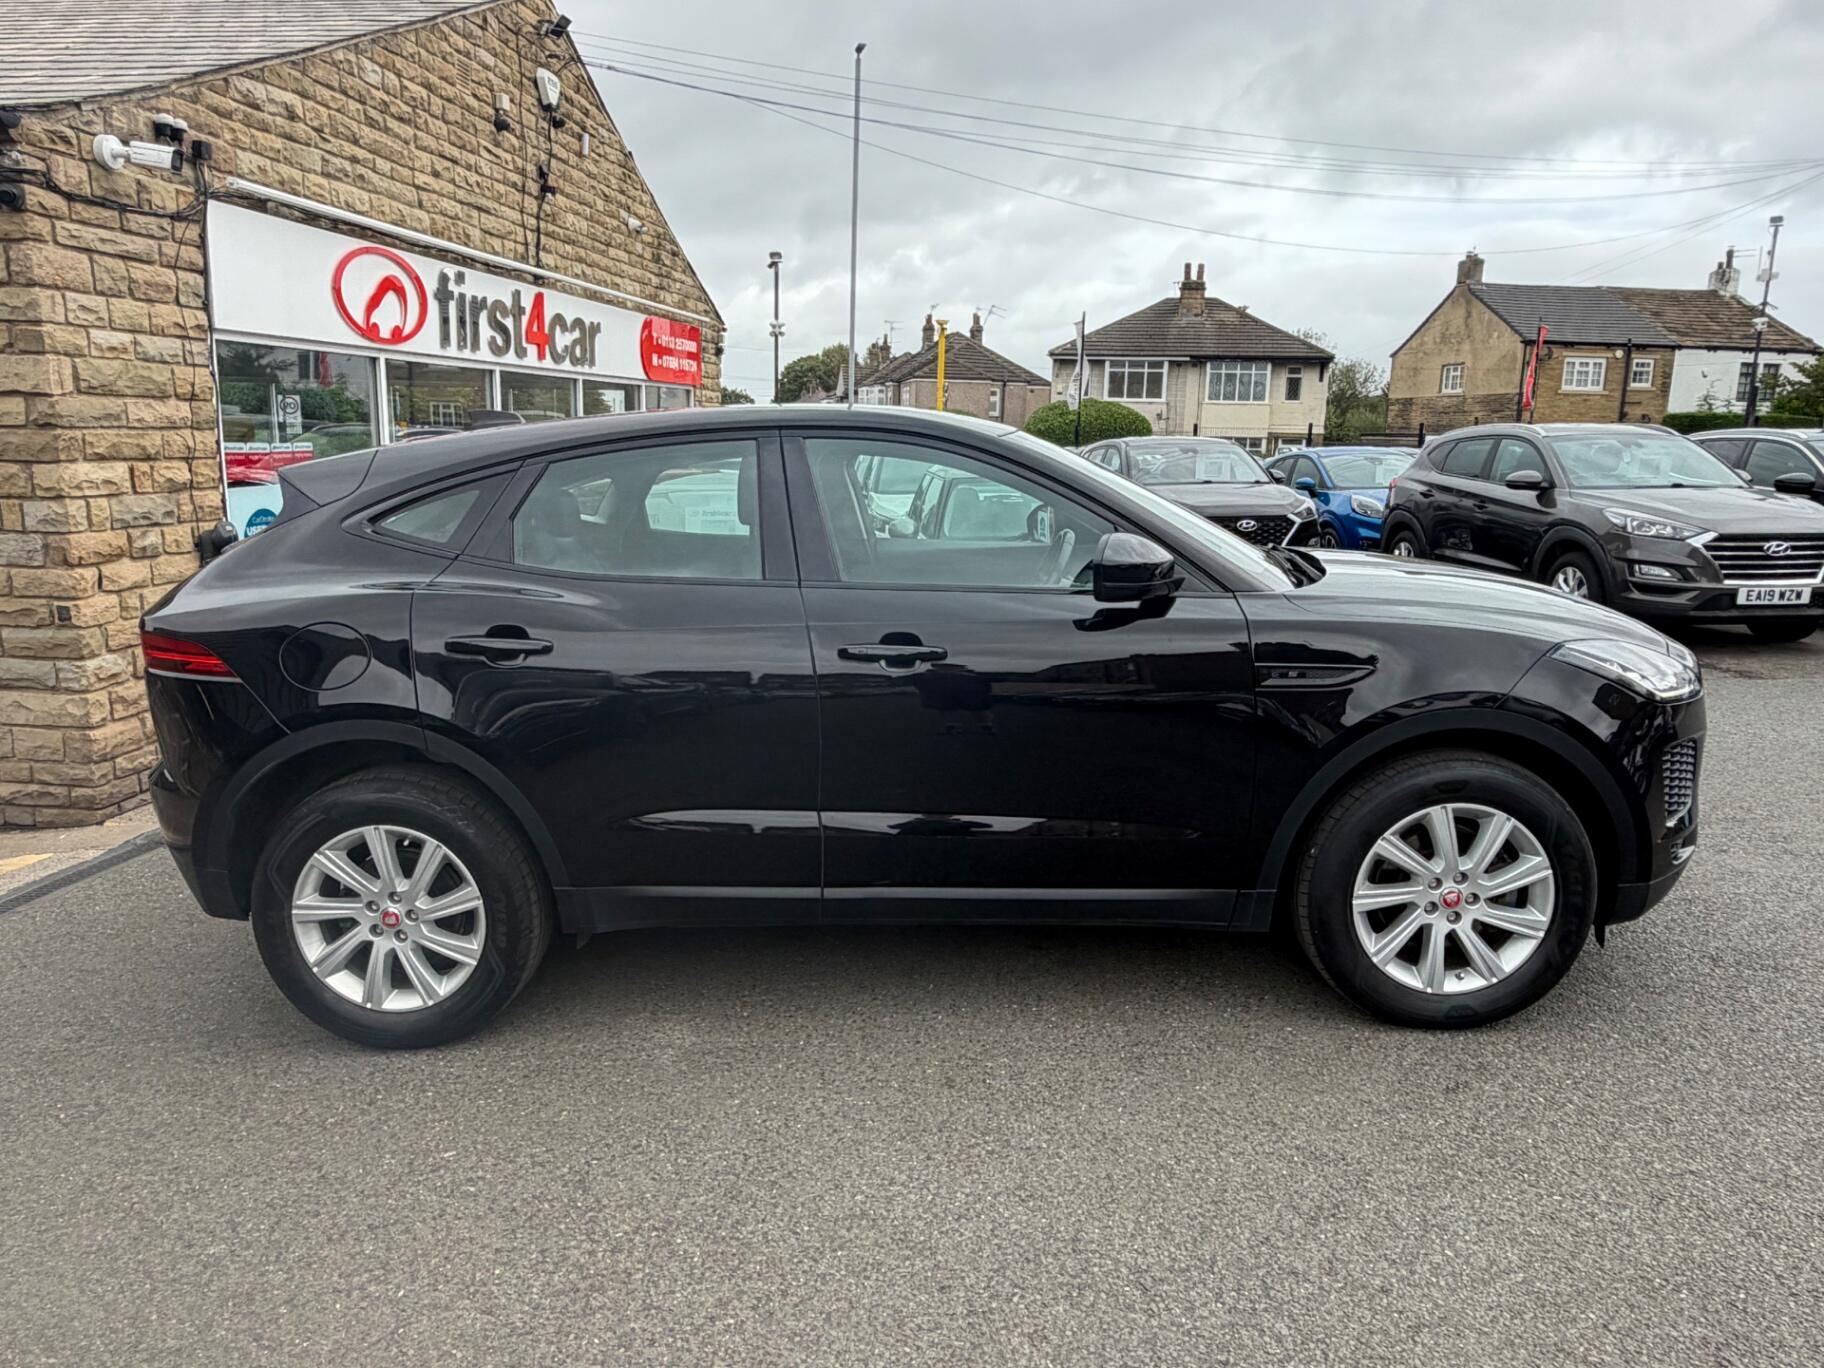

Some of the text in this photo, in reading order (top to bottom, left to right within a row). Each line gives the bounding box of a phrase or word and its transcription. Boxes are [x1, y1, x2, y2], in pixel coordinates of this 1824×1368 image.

[433, 267, 602, 369] first4car
[1745, 589, 1804, 602] EA19 WZW
